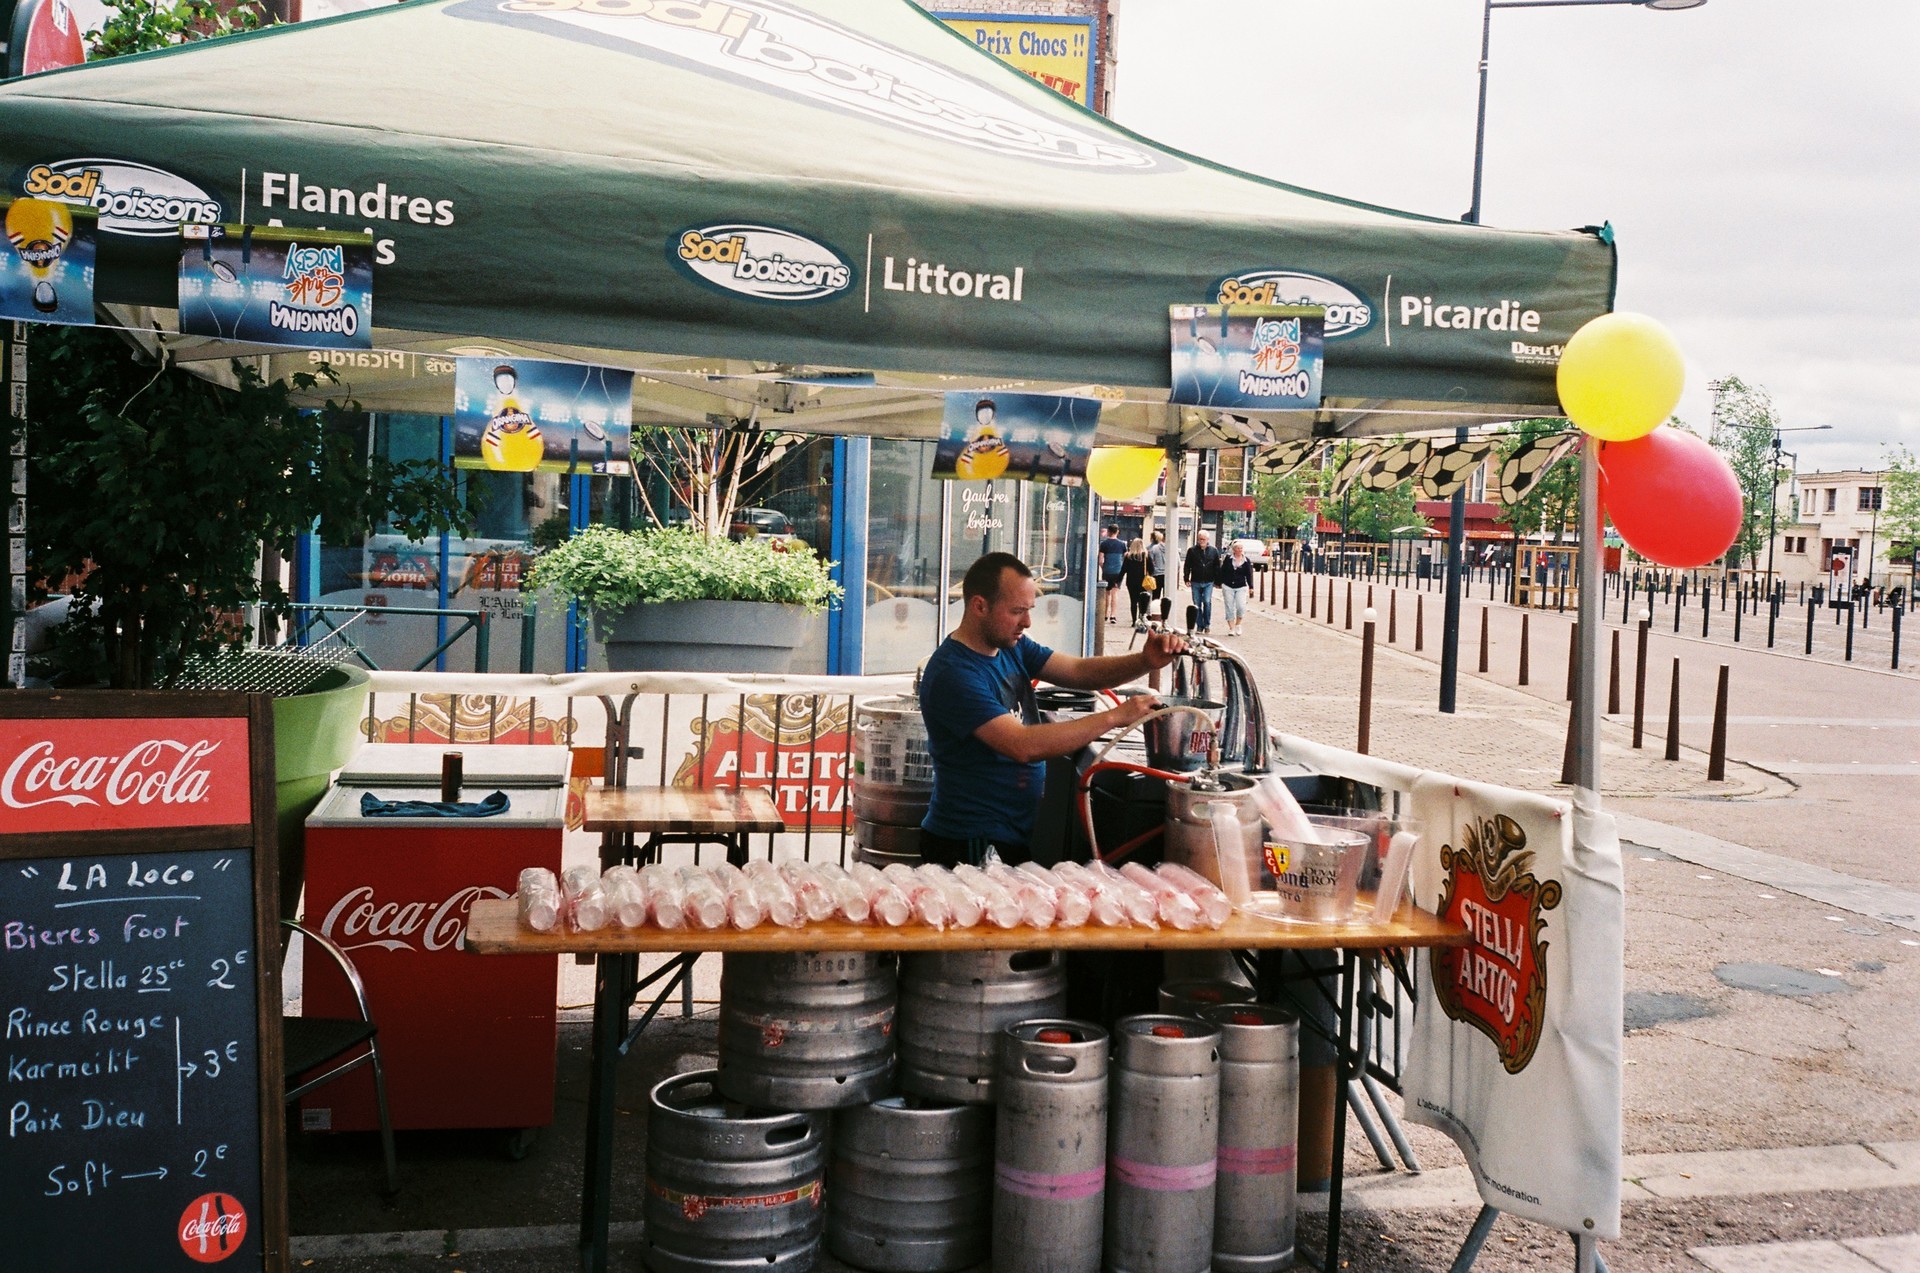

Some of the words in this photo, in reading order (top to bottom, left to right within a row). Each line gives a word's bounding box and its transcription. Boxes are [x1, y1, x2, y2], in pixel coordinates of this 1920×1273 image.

[975, 29, 1013, 55] Prix
[1019, 31, 1068, 57] Chocs
[25, 165, 100, 198] Sodi
[91, 186, 220, 223] boissons
[262, 171, 456, 226] Flandres
[284, 243, 344, 279] RUGBY
[679, 230, 745, 264] Sodi
[735, 251, 850, 290] boissons
[286, 275, 344, 306] Shake
[884, 256, 1024, 301] Littoral
[1219, 279, 1278, 305] Sodi
[270, 301, 358, 337] ORANGINA
[1400, 296, 1541, 332] Picardie
[1252, 317, 1300, 348] RUGBY
[1253, 345, 1298, 373] Shake
[1239, 370, 1310, 398] ORANGINA
[1, 740, 223, 808] Coca-Cola
[57, 863, 107, 891] LA
[4, 921, 100, 950] Bieres
[1460, 897, 1524, 970] STELLA
[48, 960, 128, 992] Stella
[82, 1008, 165, 1038] Rouge
[10, 1101, 62, 1138] Paix
[81, 1100, 145, 1130] Dieu
[44, 1160, 112, 1196] Soft
[182, 1212, 243, 1242] Coca-Cola
